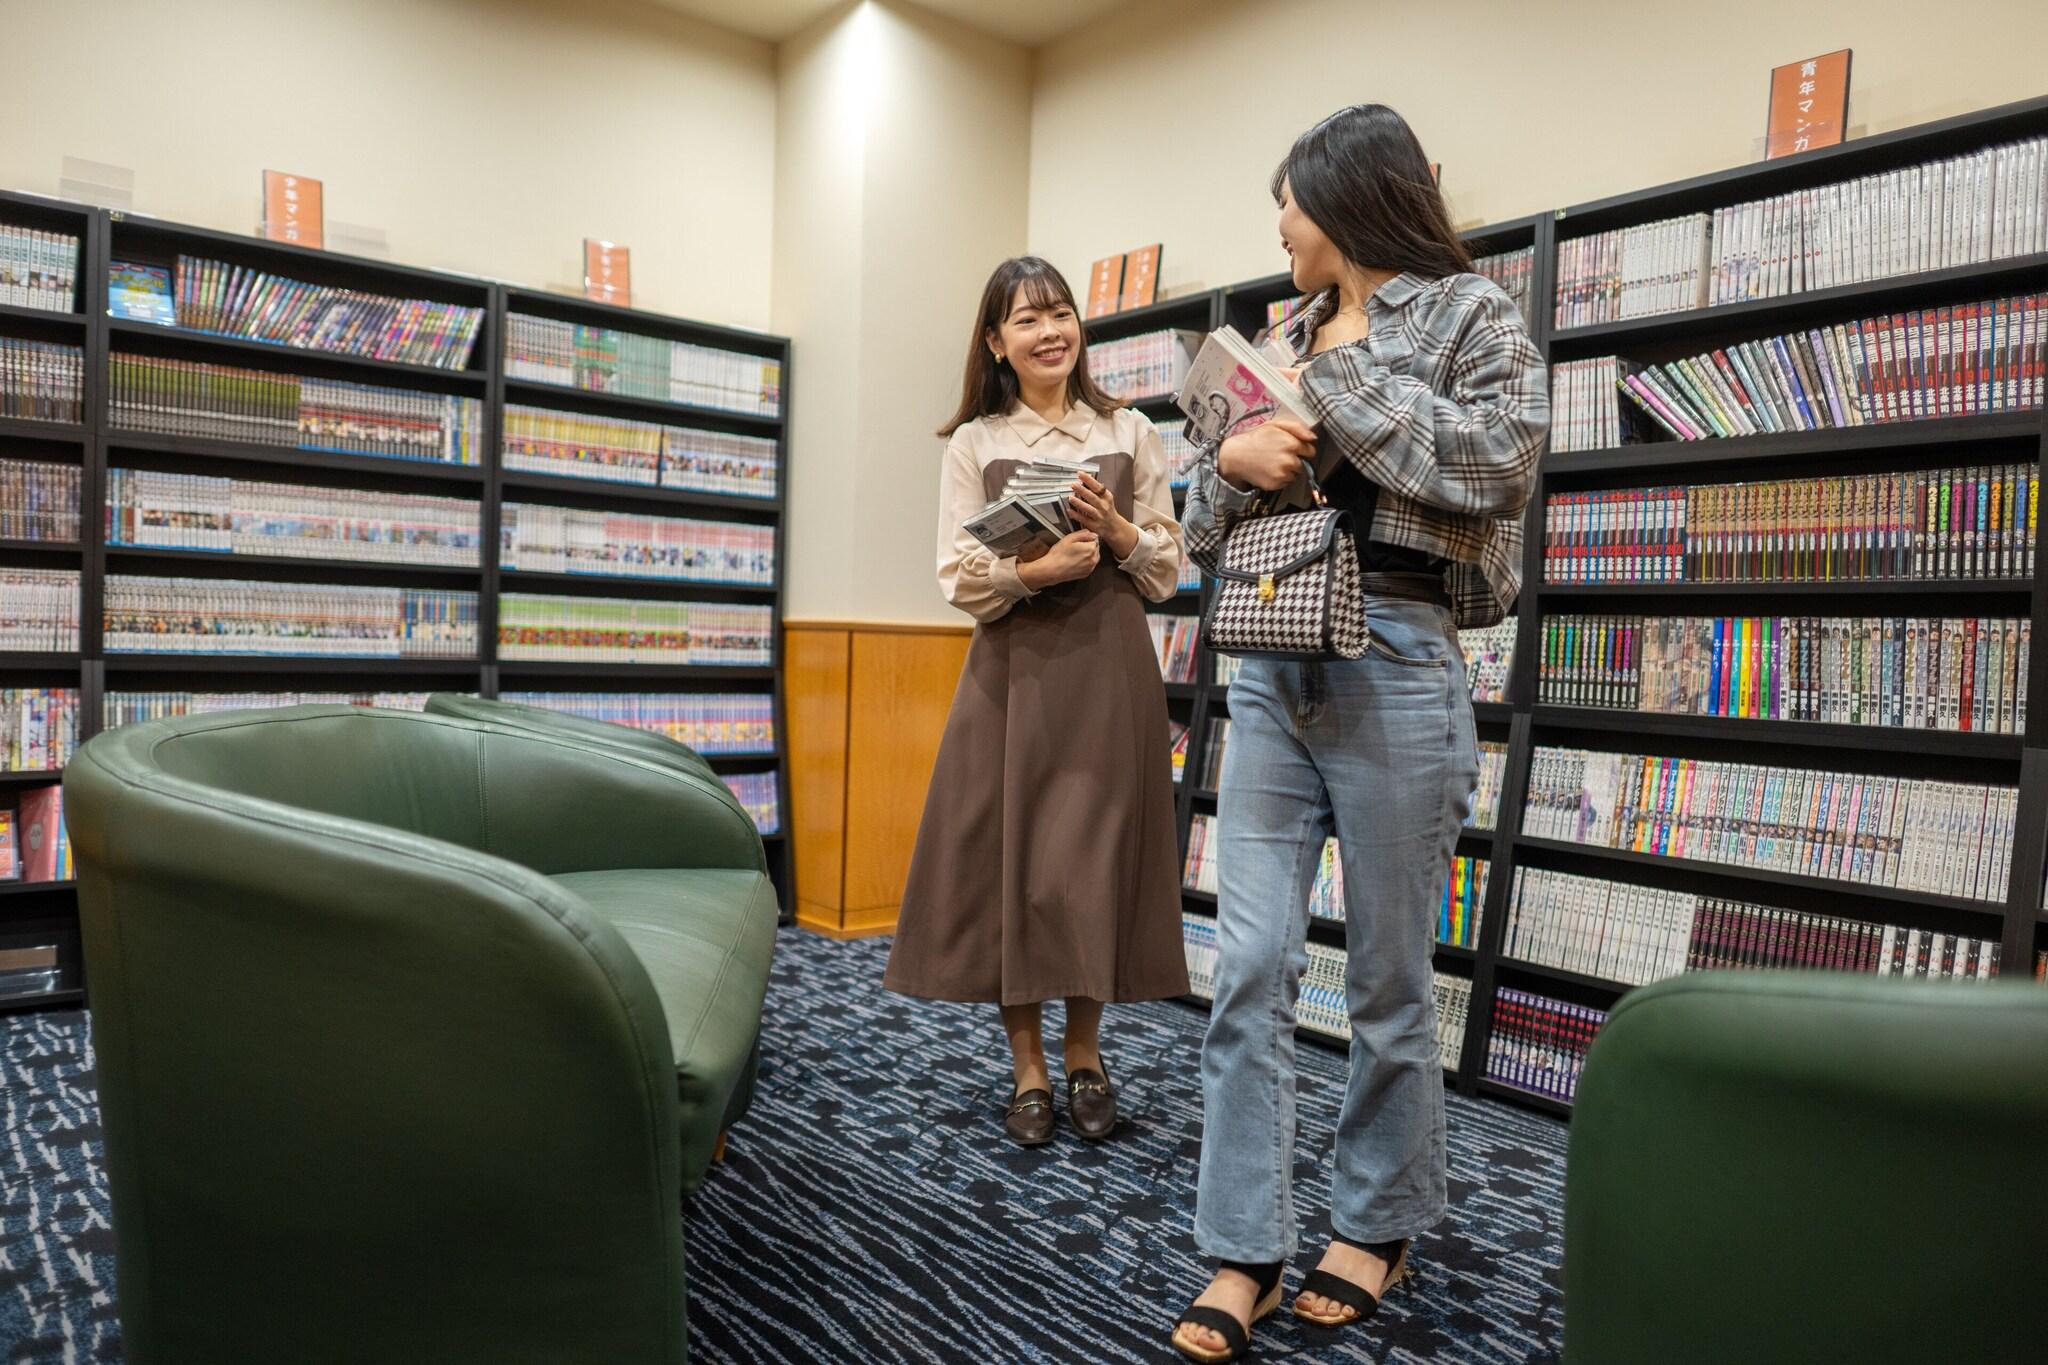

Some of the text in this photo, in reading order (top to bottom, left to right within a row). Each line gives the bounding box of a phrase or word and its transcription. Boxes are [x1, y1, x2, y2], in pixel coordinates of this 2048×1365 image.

[1794, 60, 1816, 152] 青年マンガ
